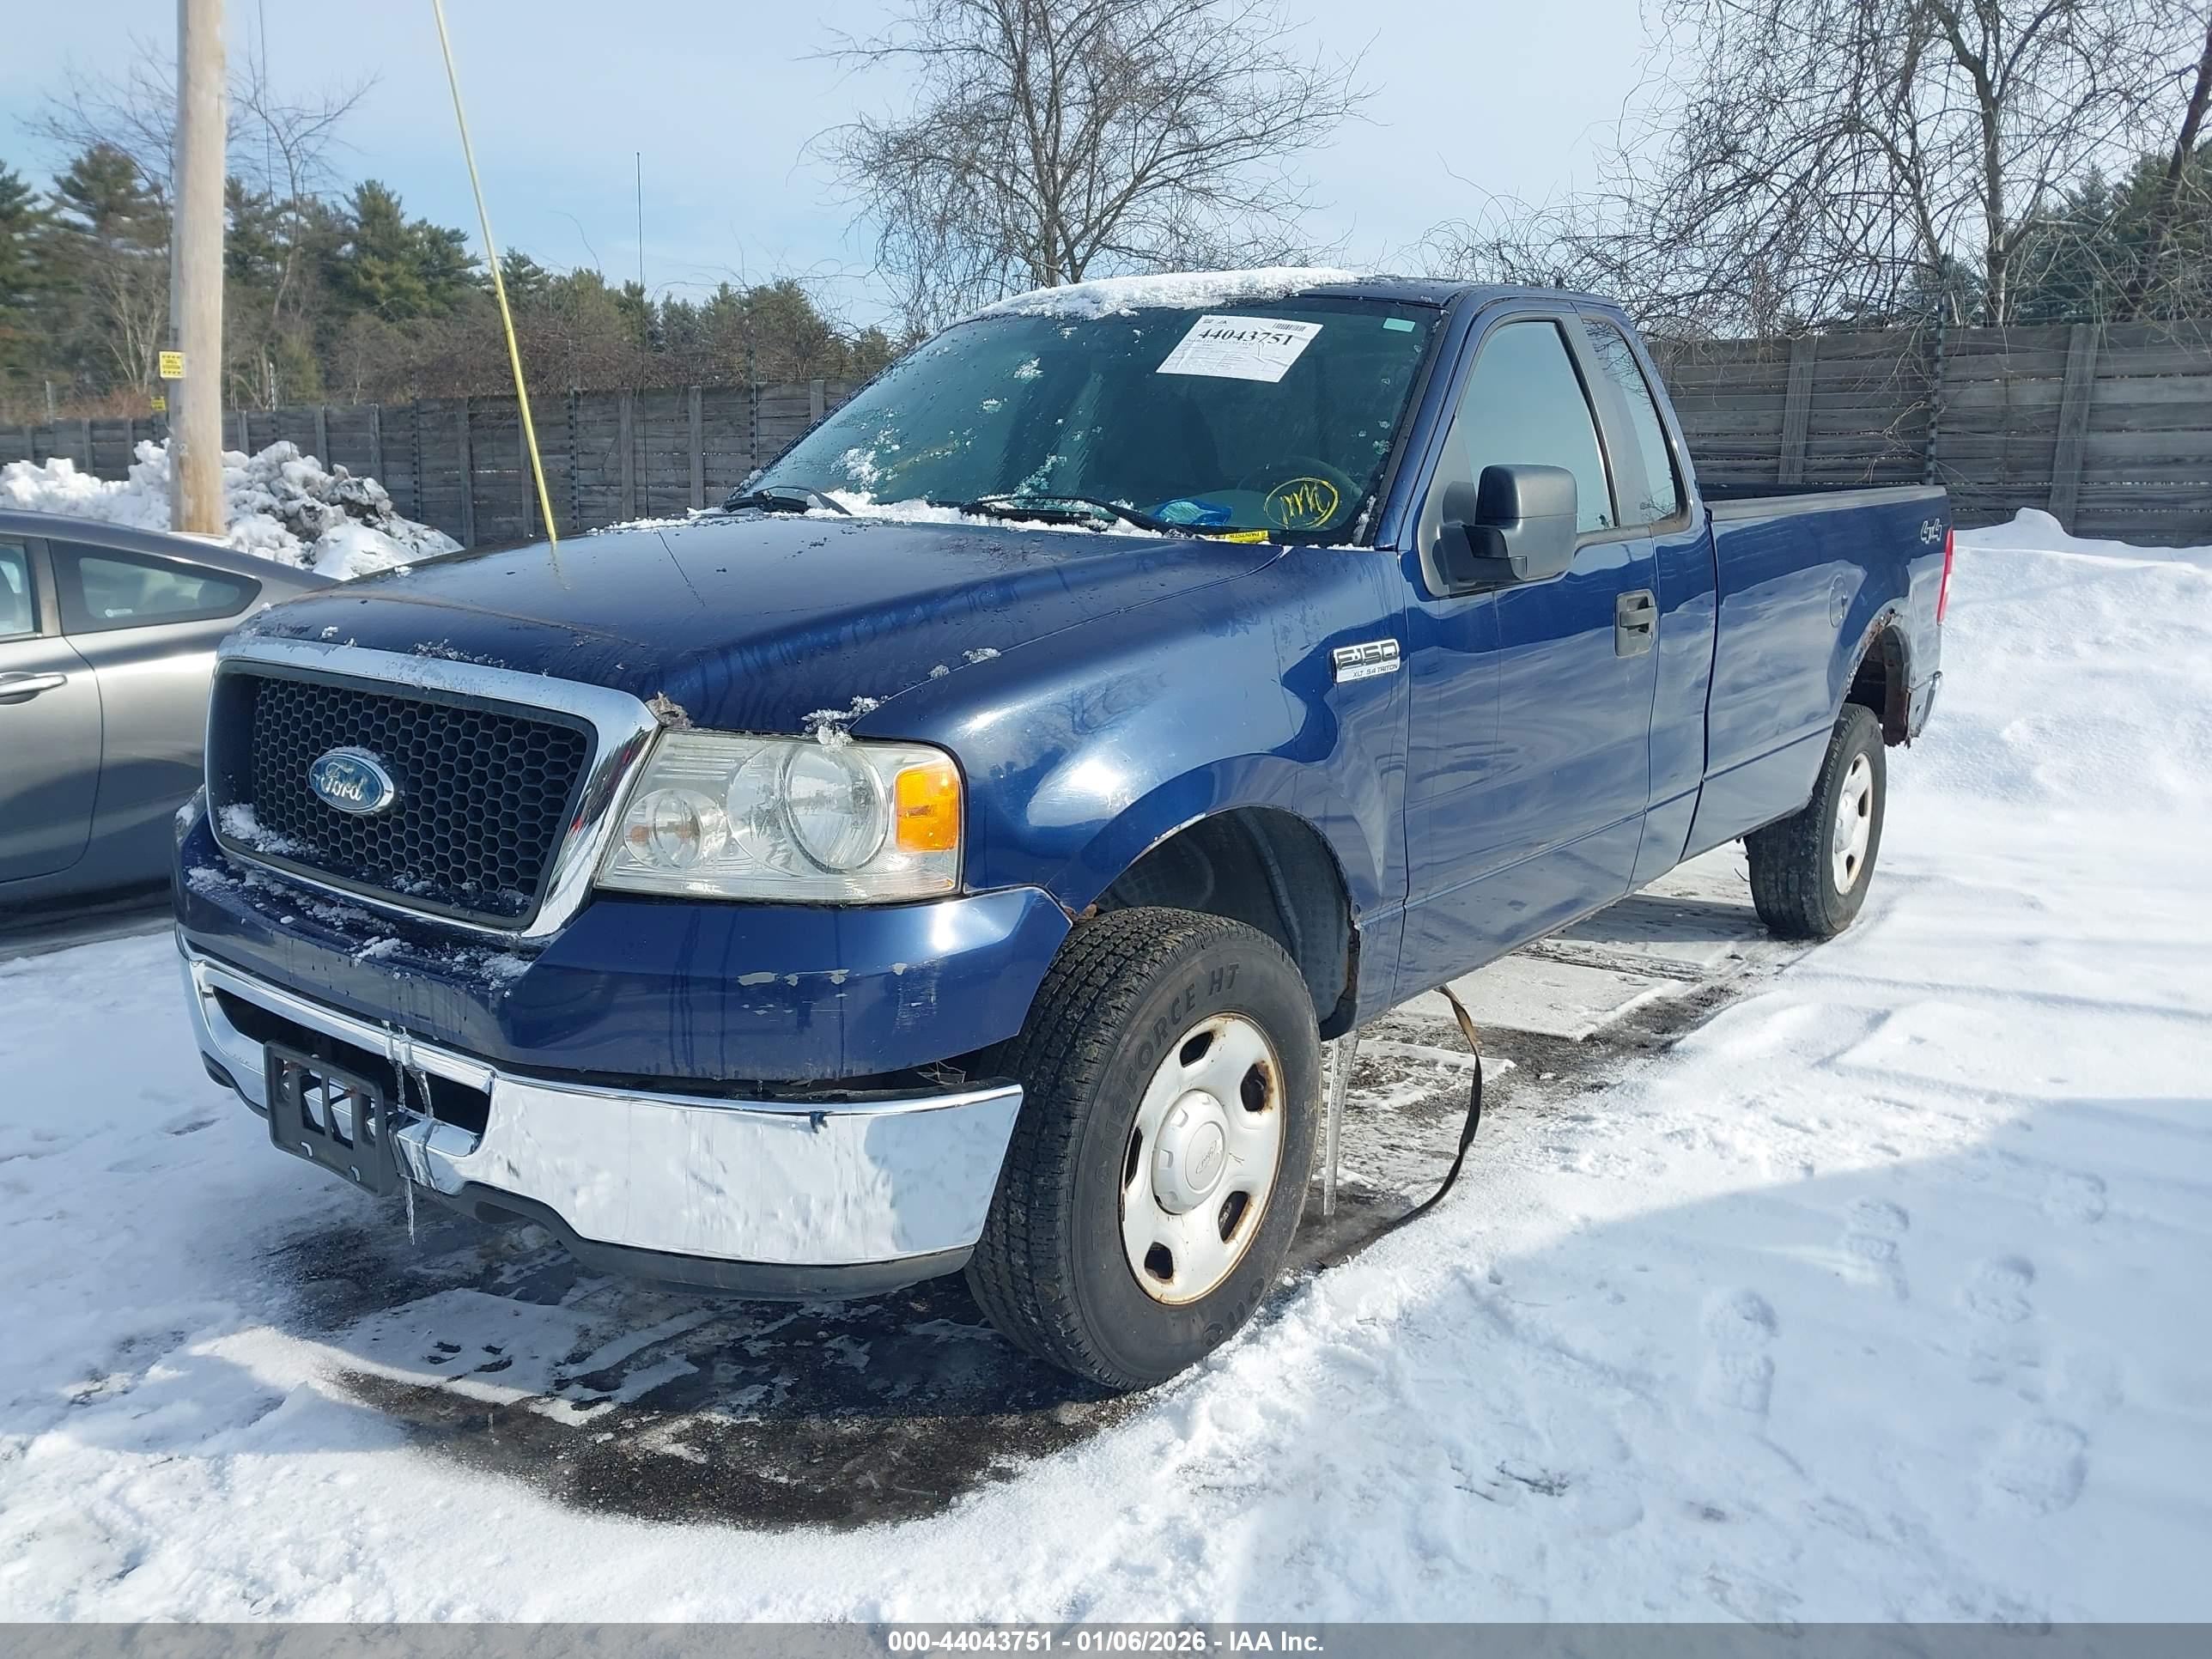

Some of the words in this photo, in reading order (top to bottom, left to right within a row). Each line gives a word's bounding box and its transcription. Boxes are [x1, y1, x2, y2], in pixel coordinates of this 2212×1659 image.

[1198, 328, 1293, 345] 44043751
[1920, 518, 1942, 544] 4x4
[1376, 664, 1398, 672] TRITON
[320, 762, 365, 801] Ford
[1208, 963, 1239, 997] HT
